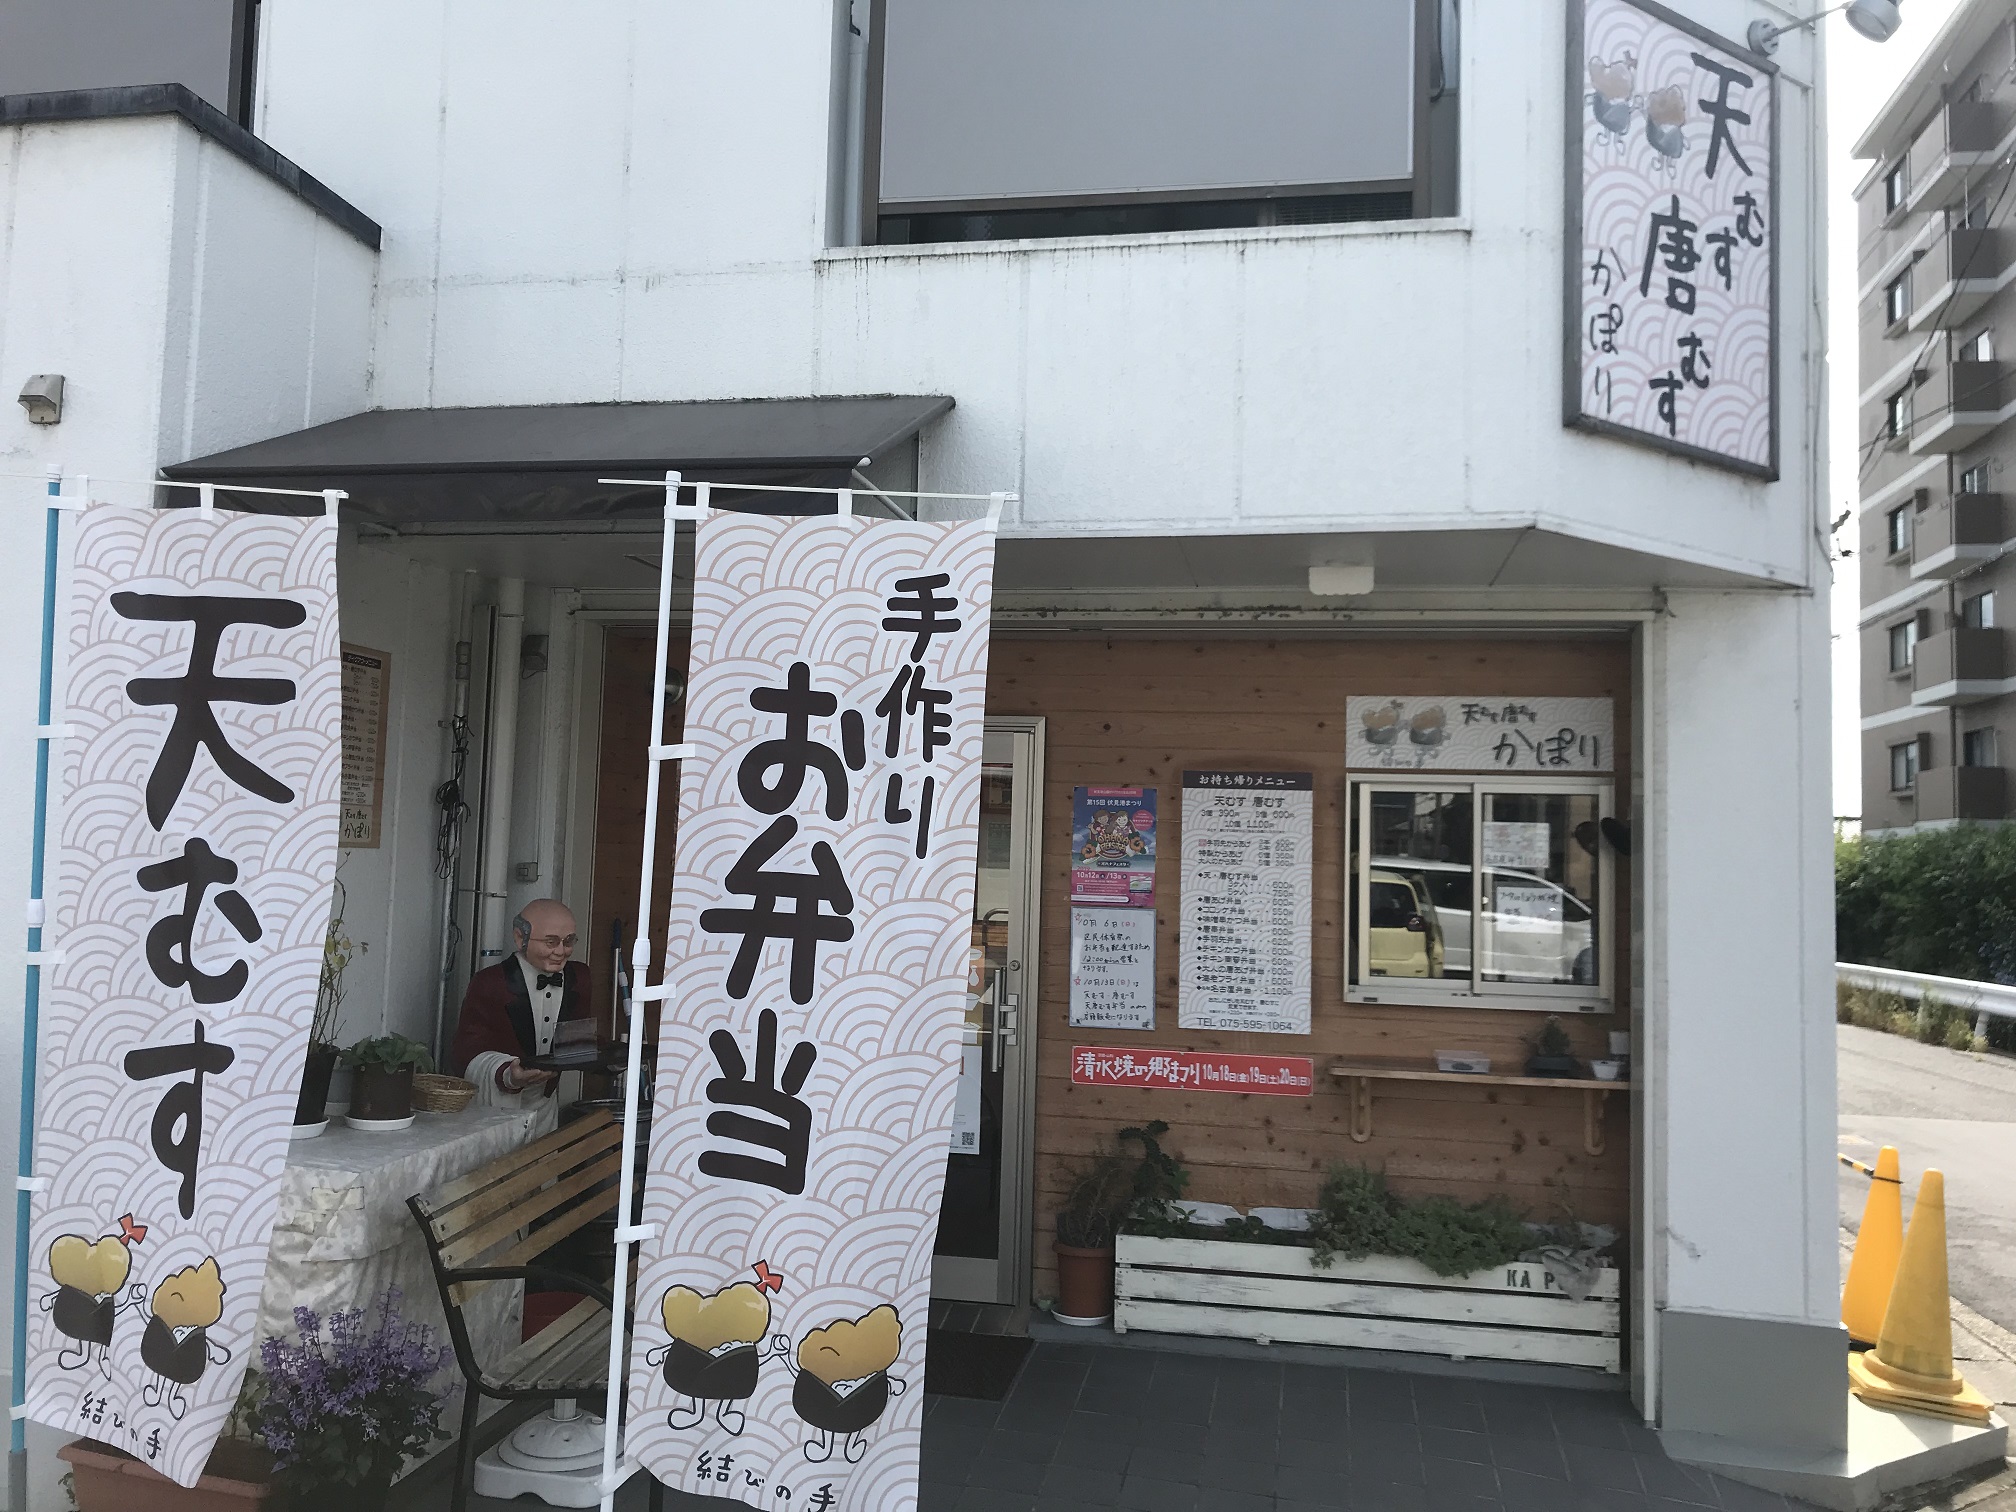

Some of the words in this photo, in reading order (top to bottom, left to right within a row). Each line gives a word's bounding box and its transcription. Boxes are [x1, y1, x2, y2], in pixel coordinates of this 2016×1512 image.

[1691, 52, 1764, 290] 天むす
[1590, 247, 1626, 414] かぽり
[877, 573, 961, 860] 手作り
[1493, 728, 1598, 767] かぽり
[1200, 774, 1296, 786] お持ち帰りメニュー
[1214, 796, 1247, 807] 天むす
[1252, 796, 1286, 808] 唐むす
[110, 591, 306, 1220] 天むす
[698, 662, 866, 1195] お弁当
[1197, 1017, 1216, 1027] TEL
[1220, 1018, 1292, 1031] 075-595-1064
[1074, 1052, 1200, 1086] 清水焼の郷まつり
[1506, 1268, 1563, 1290] KAP
[697, 1450, 836, 1512] 結びの手
